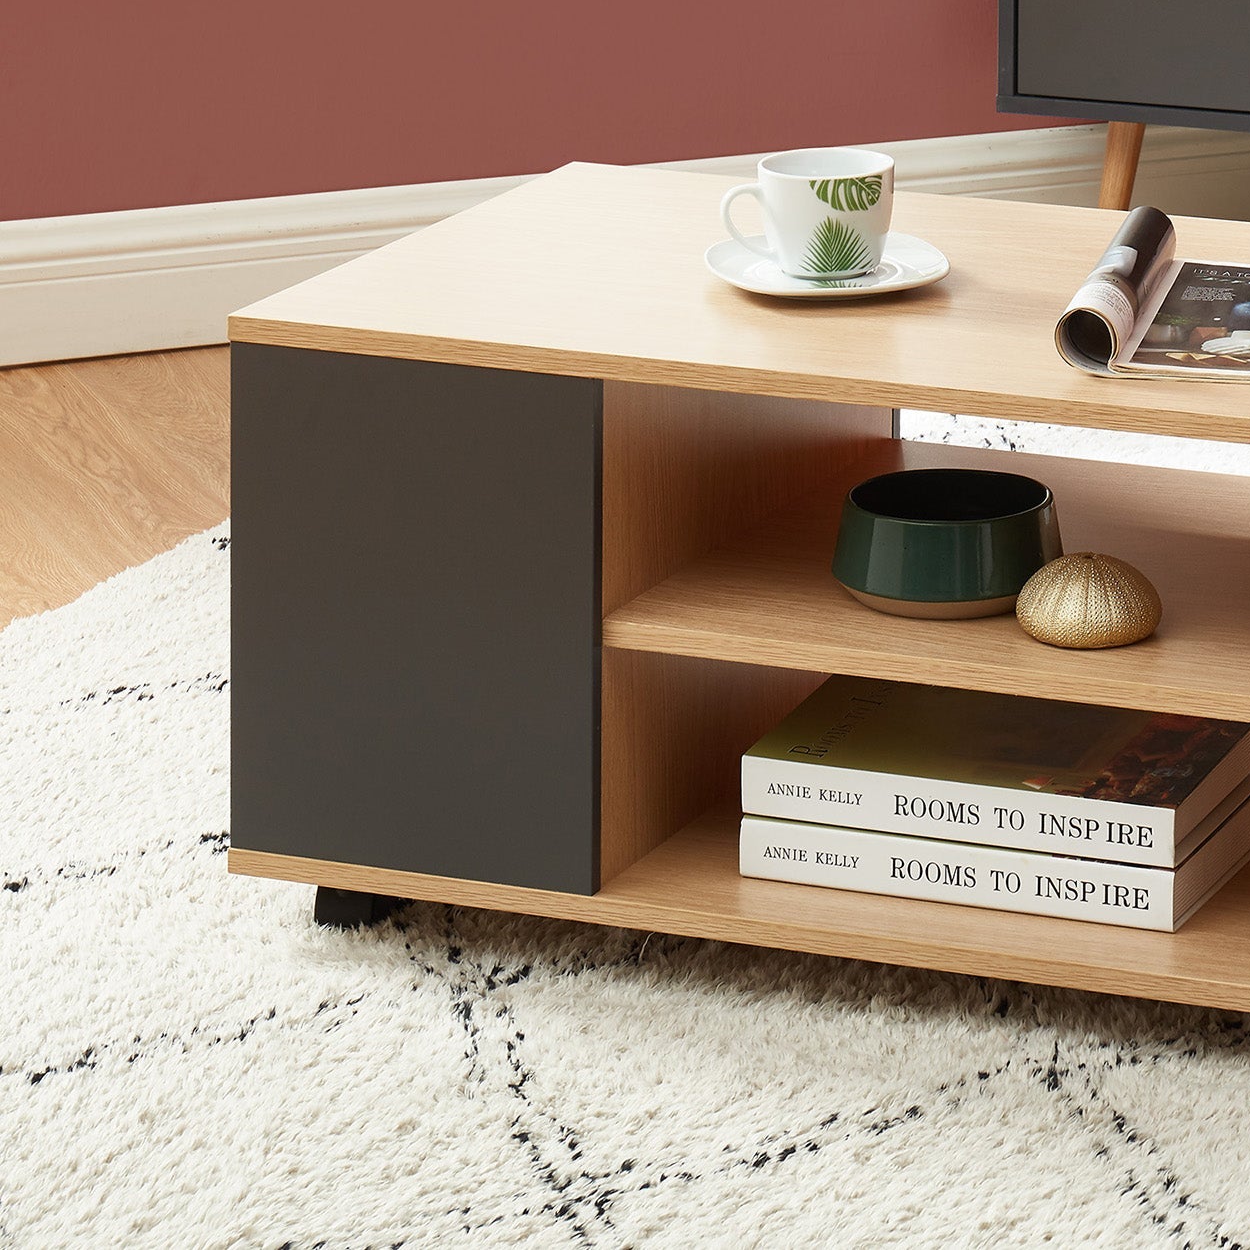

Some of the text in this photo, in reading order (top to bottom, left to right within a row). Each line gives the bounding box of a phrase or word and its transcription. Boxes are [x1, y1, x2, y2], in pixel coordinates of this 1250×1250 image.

[767, 782, 1153, 848] ANNIE KELLY ROOMS TO INSPIRE
[763, 846, 1149, 910] ANNIE KELLY ROOMS TO INSPIRE
